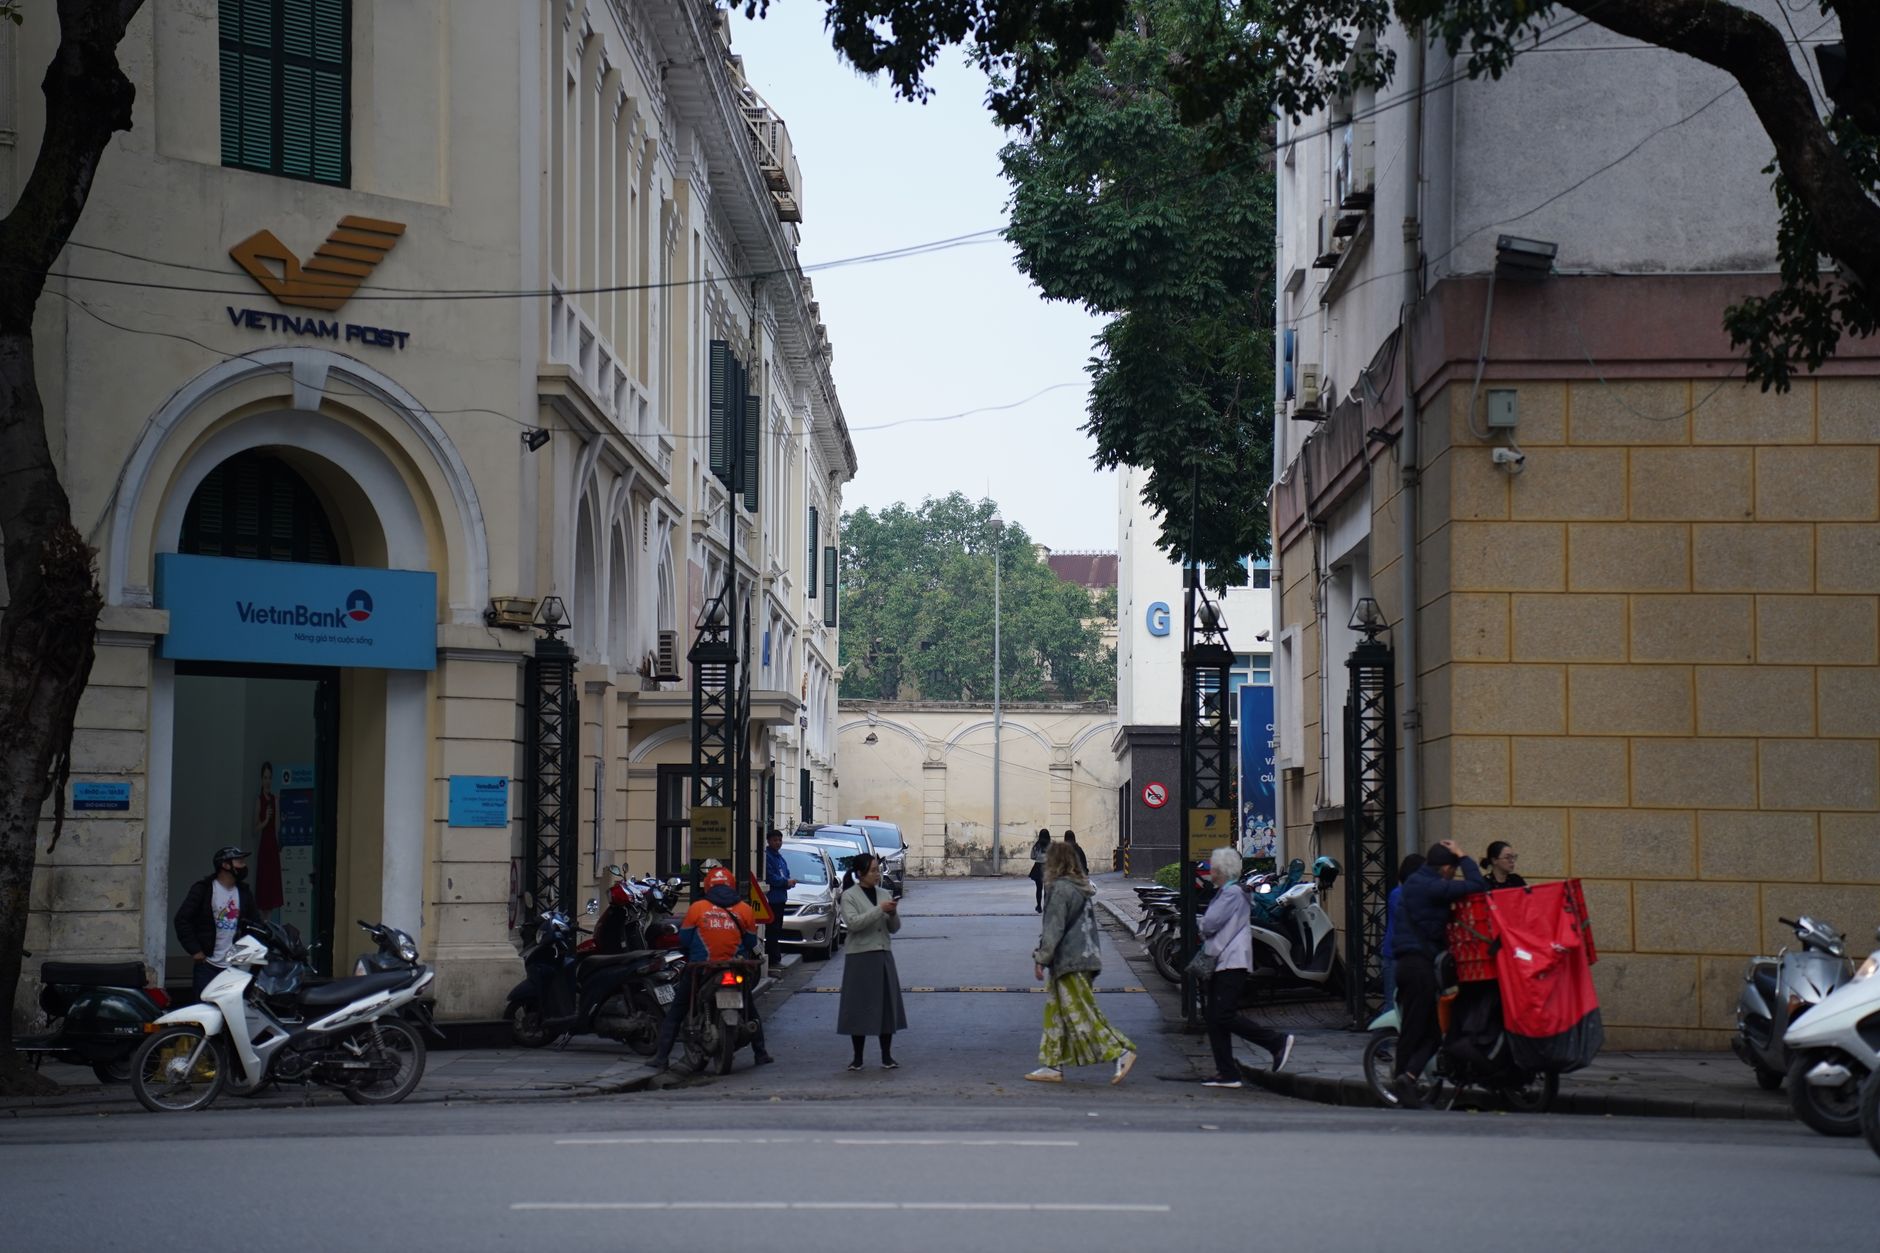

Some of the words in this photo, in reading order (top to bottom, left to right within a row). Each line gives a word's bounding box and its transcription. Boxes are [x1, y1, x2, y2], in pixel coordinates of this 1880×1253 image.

[227, 306, 339, 340] VIETNAM
[346, 323, 410, 350] POST
[236, 601, 347, 628] VietinBank
[1146, 601, 1170, 637] G
[295, 633, 313, 643] Nâng
[316, 634, 327, 643] giá
[337, 636, 354, 644] cuộc
[357, 636, 373, 646] sống
[1260, 772, 1275, 782] CỦ
